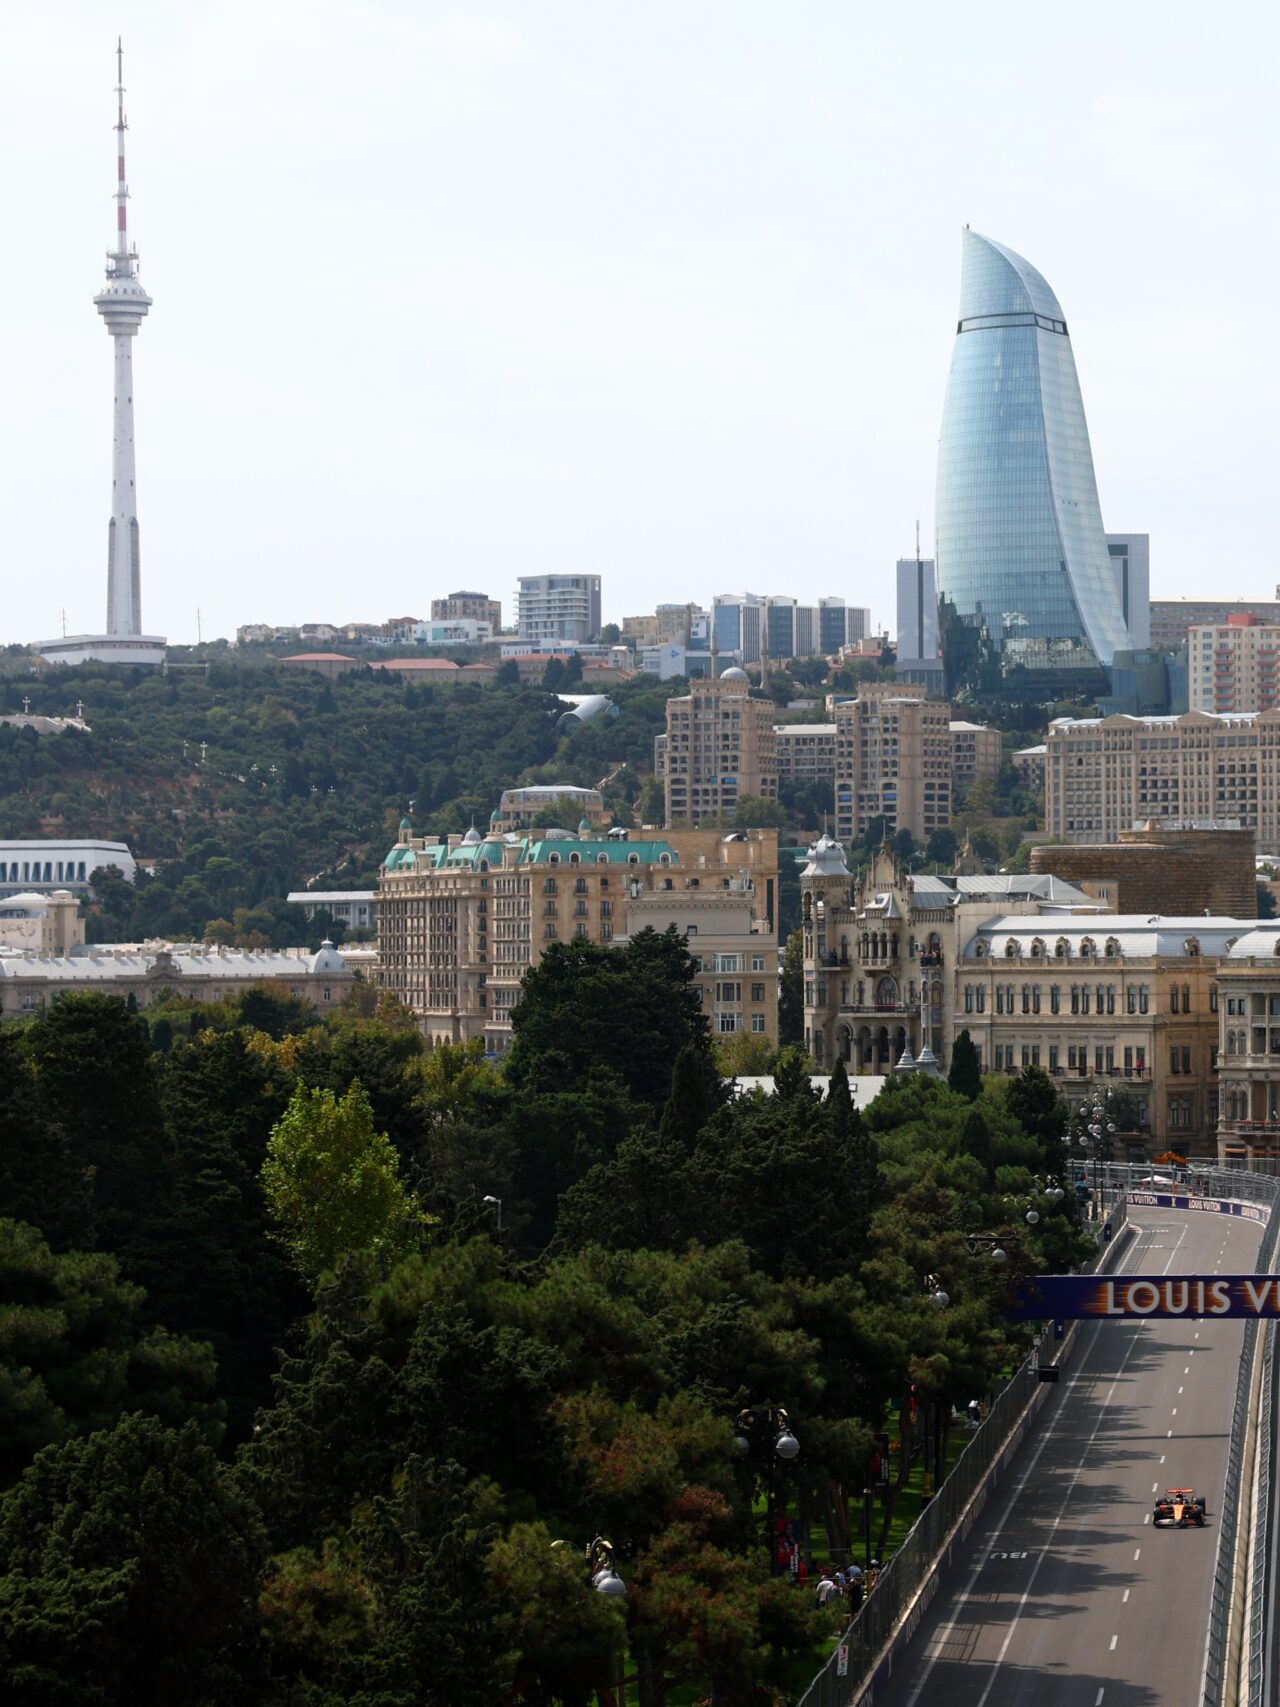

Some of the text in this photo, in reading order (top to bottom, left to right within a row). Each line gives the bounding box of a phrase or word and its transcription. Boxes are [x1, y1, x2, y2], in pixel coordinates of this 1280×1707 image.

[1135, 1194, 1158, 1206] VUITTON
[1188, 1200, 1203, 1210] LOUIS
[1203, 1201, 1221, 1212] VUITTON
[1106, 1280, 1232, 1315] LOUIS
